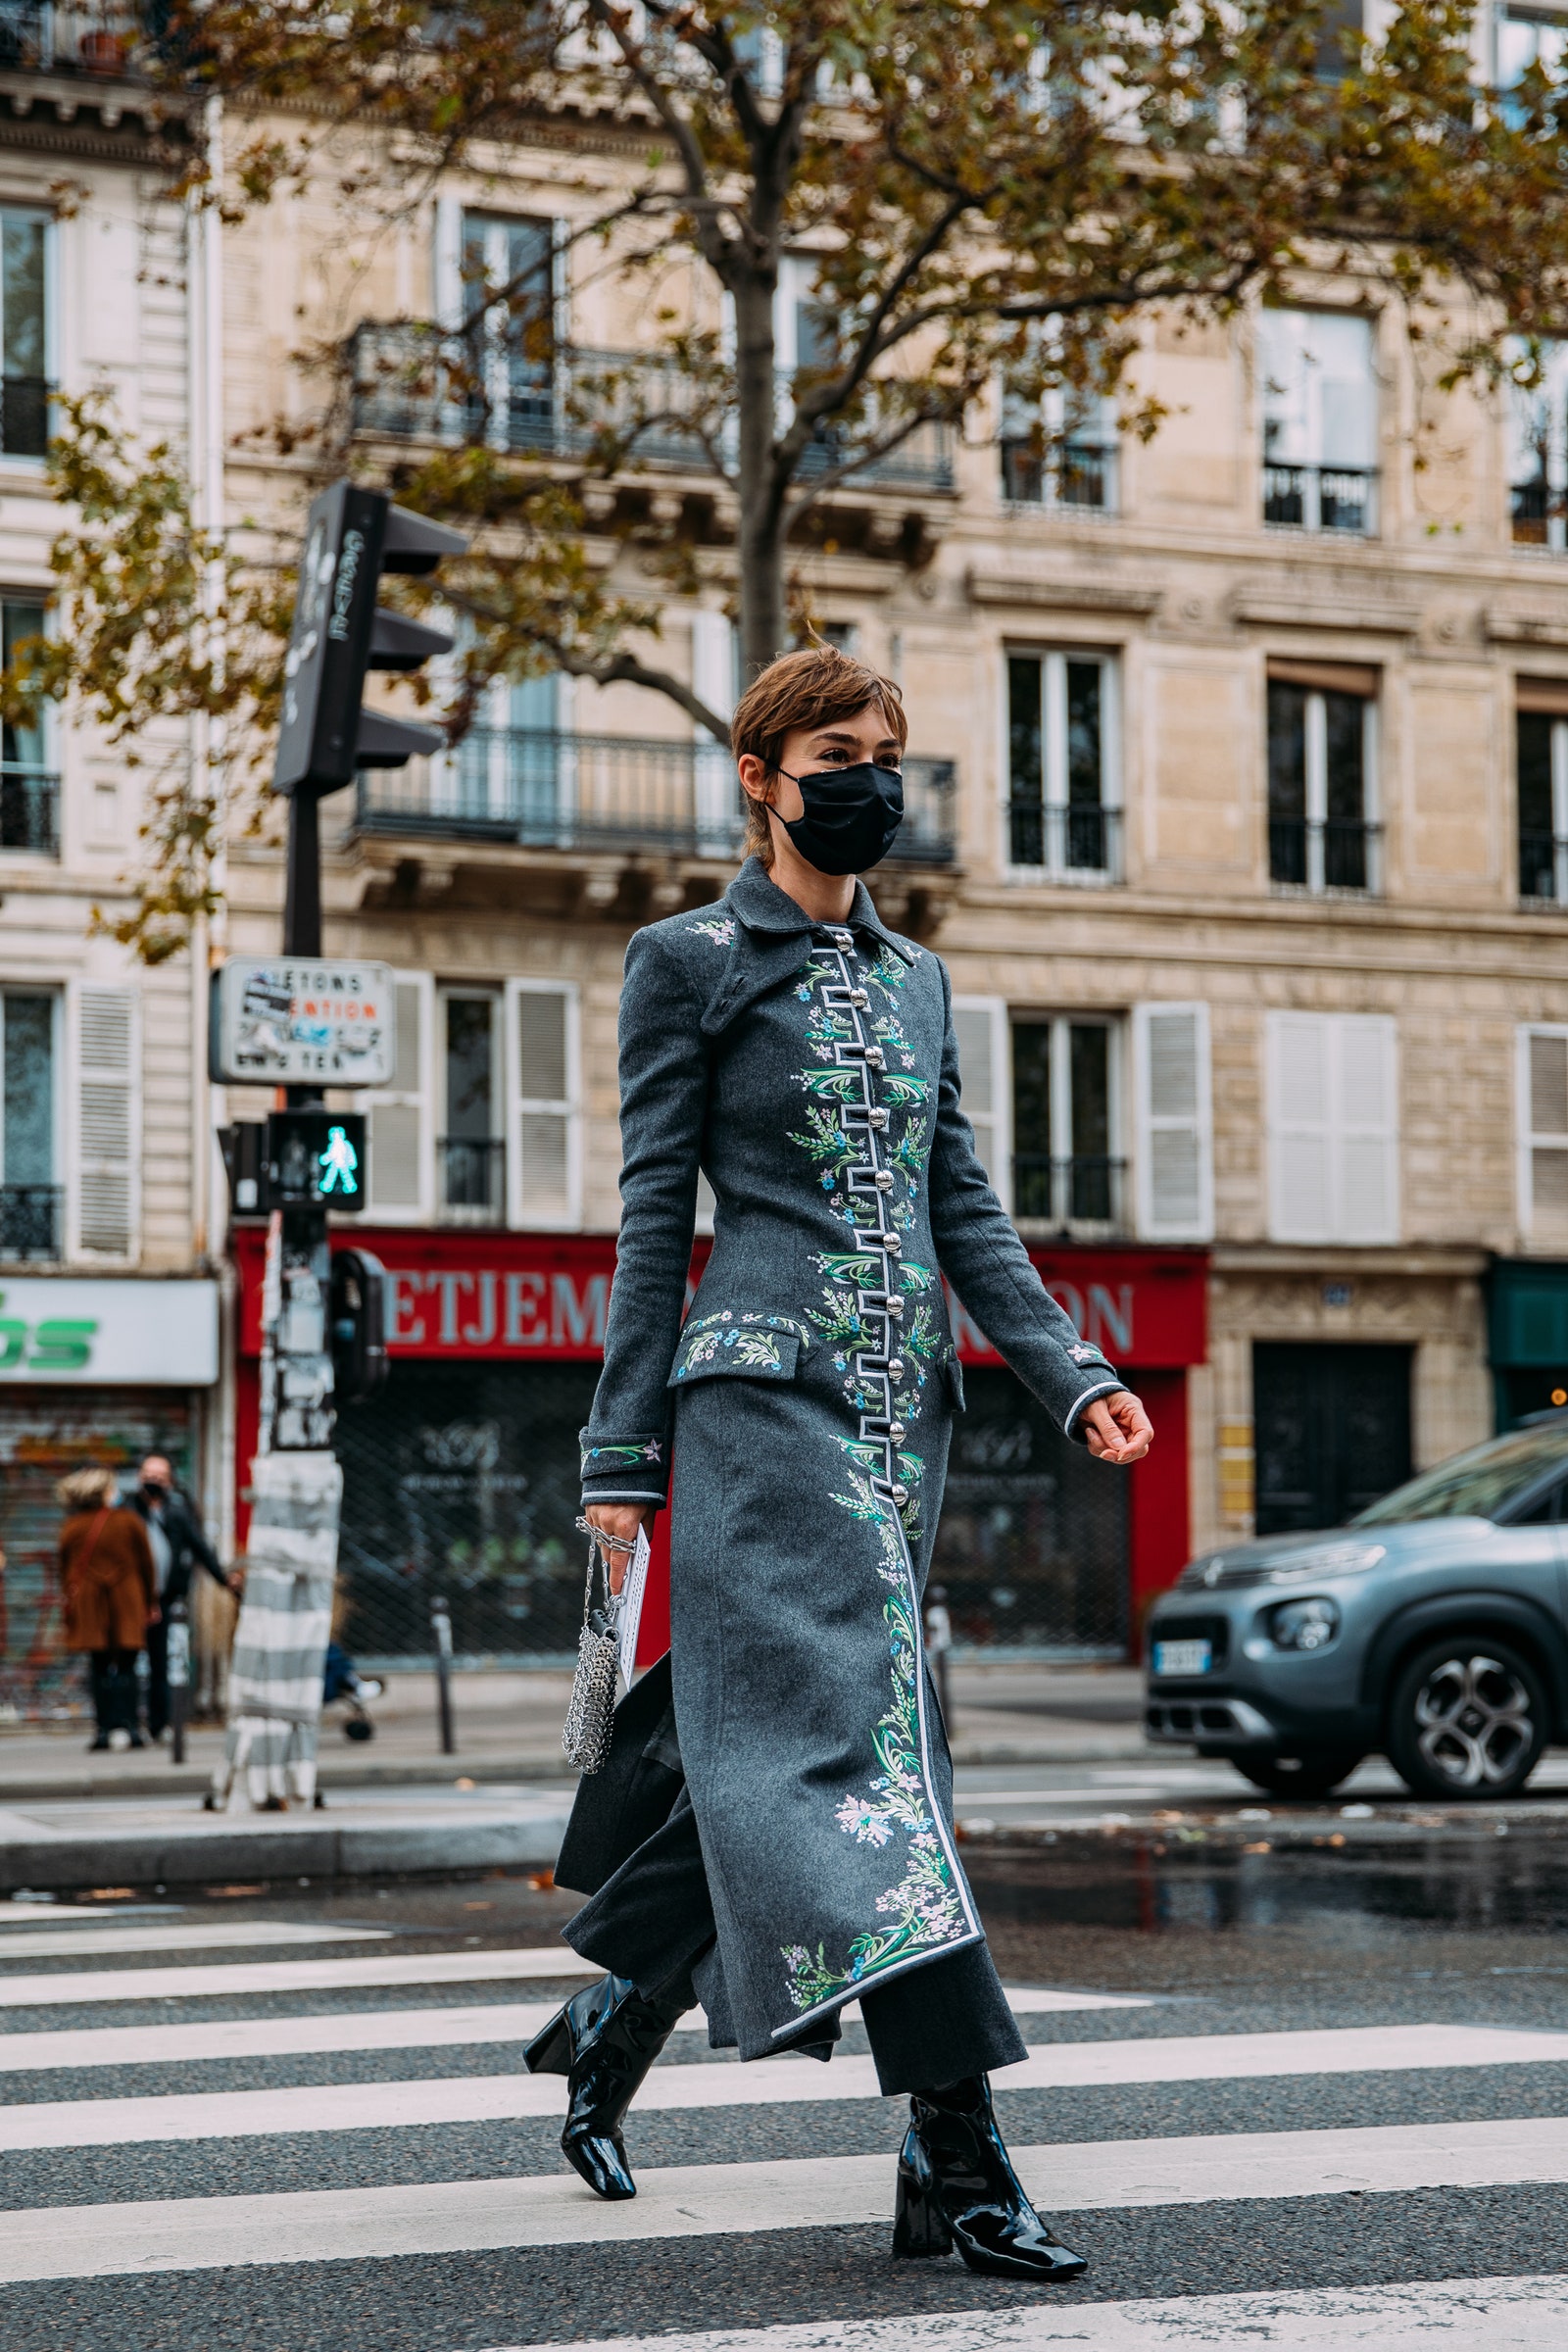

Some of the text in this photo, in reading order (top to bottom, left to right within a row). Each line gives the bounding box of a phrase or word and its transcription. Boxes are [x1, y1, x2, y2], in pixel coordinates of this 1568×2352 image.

[284, 969, 362, 993] ETONS
[290, 1000, 376, 1020] ENTION
[381, 1269, 608, 1348] ETJEM
